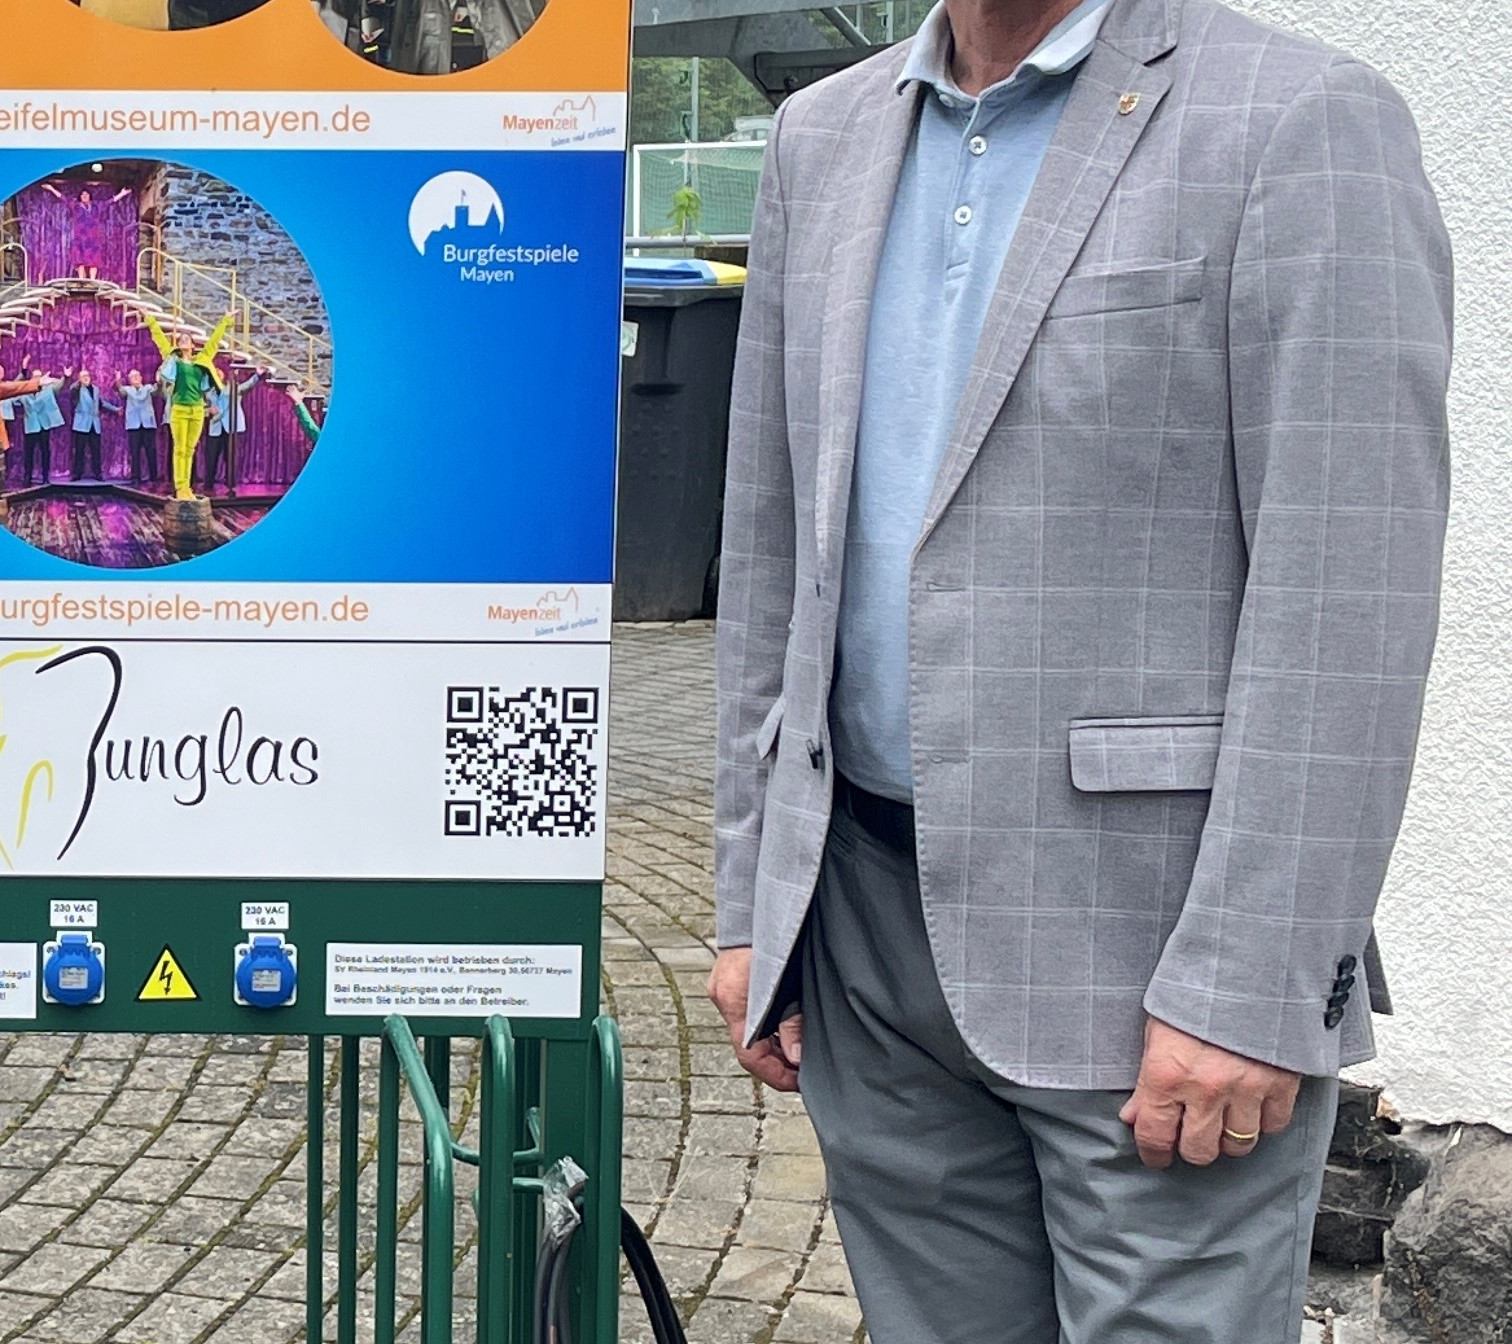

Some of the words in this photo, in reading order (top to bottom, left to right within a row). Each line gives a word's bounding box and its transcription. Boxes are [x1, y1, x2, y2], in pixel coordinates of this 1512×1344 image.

[502, 114, 579, 134] Mayenzeit
[442, 242, 580, 266] Burgfestspiele
[459, 266, 515, 283] Mayen
[487, 605, 561, 624] Mayenzeit
[53, 903, 71, 913] 230
[73, 903, 94, 913] VAC
[245, 905, 262, 915] 230
[264, 905, 285, 915] VAC
